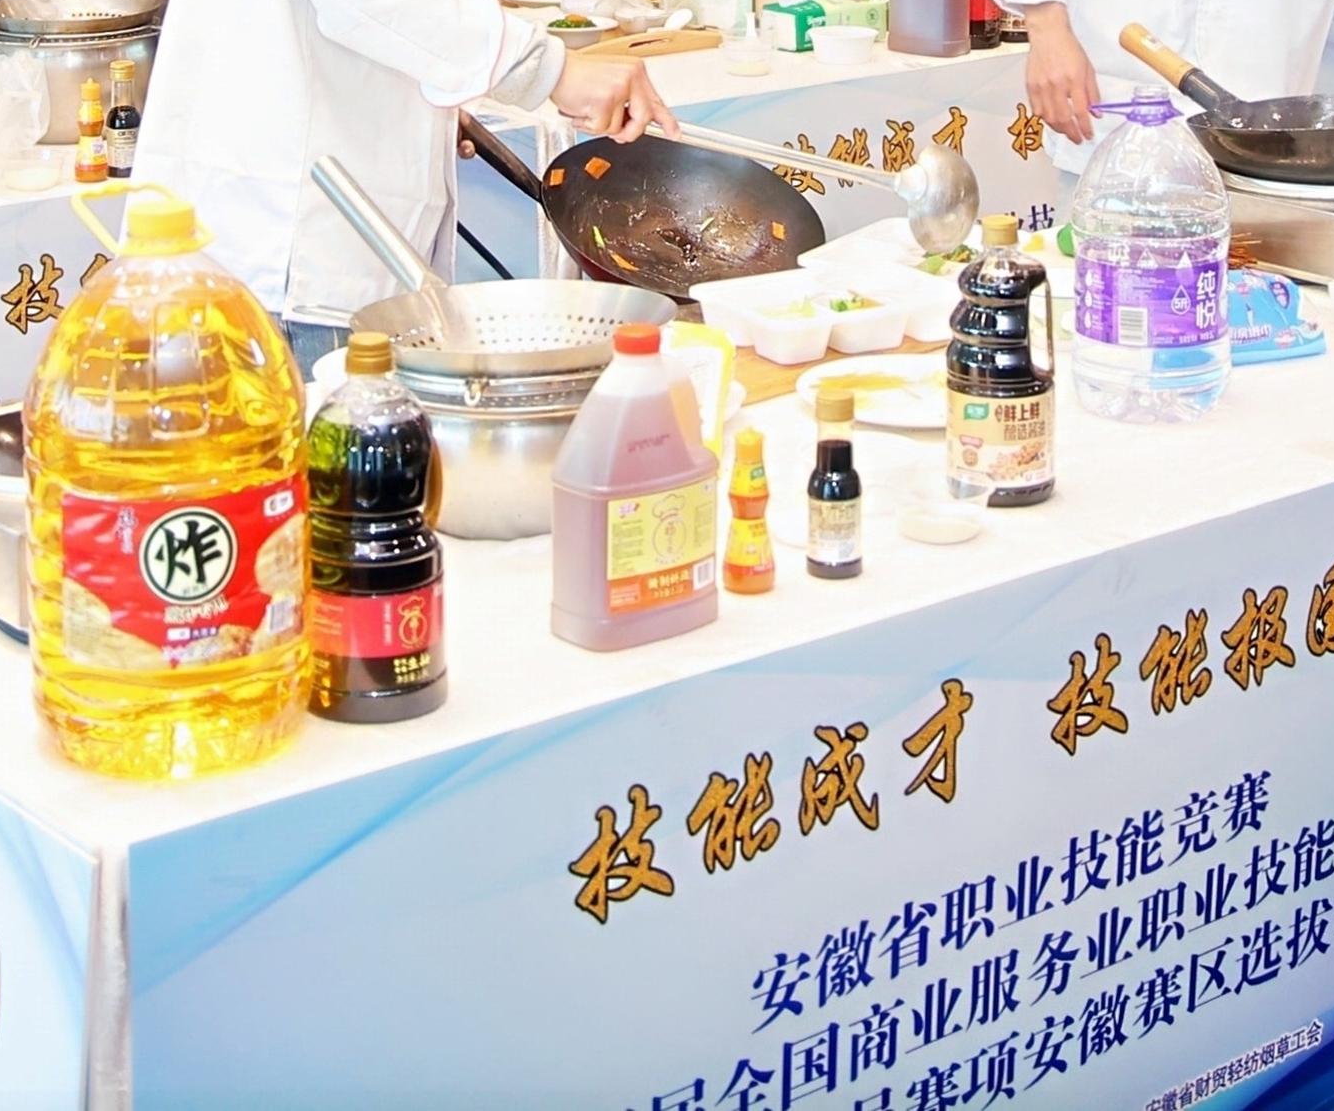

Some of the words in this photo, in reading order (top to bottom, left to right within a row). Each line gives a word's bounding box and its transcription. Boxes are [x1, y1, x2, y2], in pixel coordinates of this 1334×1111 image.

[1196, 270, 1217, 329] 纯悦
[154, 519, 223, 590] 炸
[569, 676, 974, 925] 技能成才
[751, 771, 1274, 1034] 安徽省职业技能竞赛
